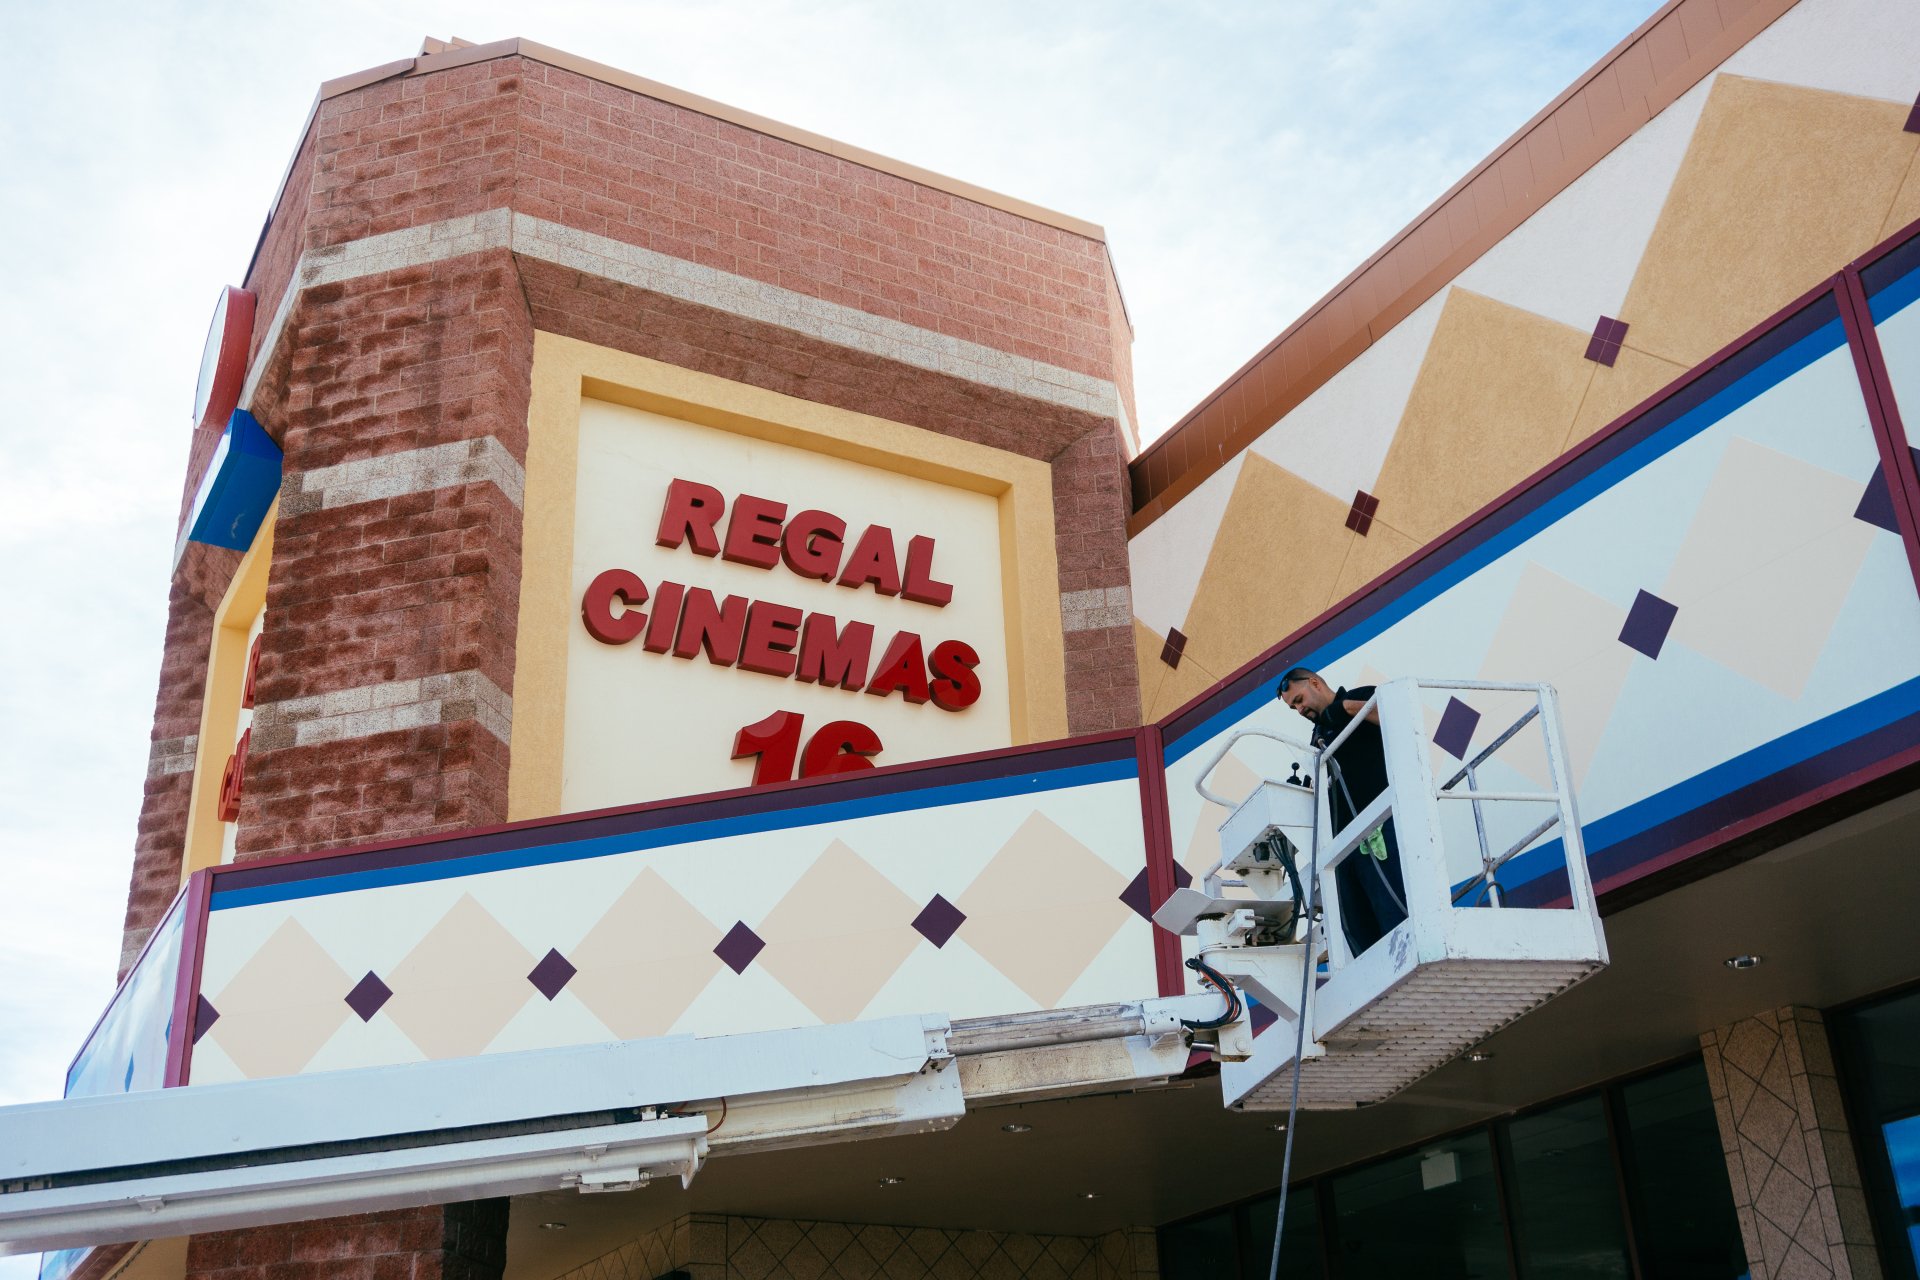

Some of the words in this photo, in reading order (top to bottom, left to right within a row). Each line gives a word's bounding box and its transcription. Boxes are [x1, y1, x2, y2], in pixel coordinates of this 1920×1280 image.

[656, 478, 953, 607] REGAL
[581, 568, 982, 712] CINEMAS
[730, 710, 884, 786] 16
